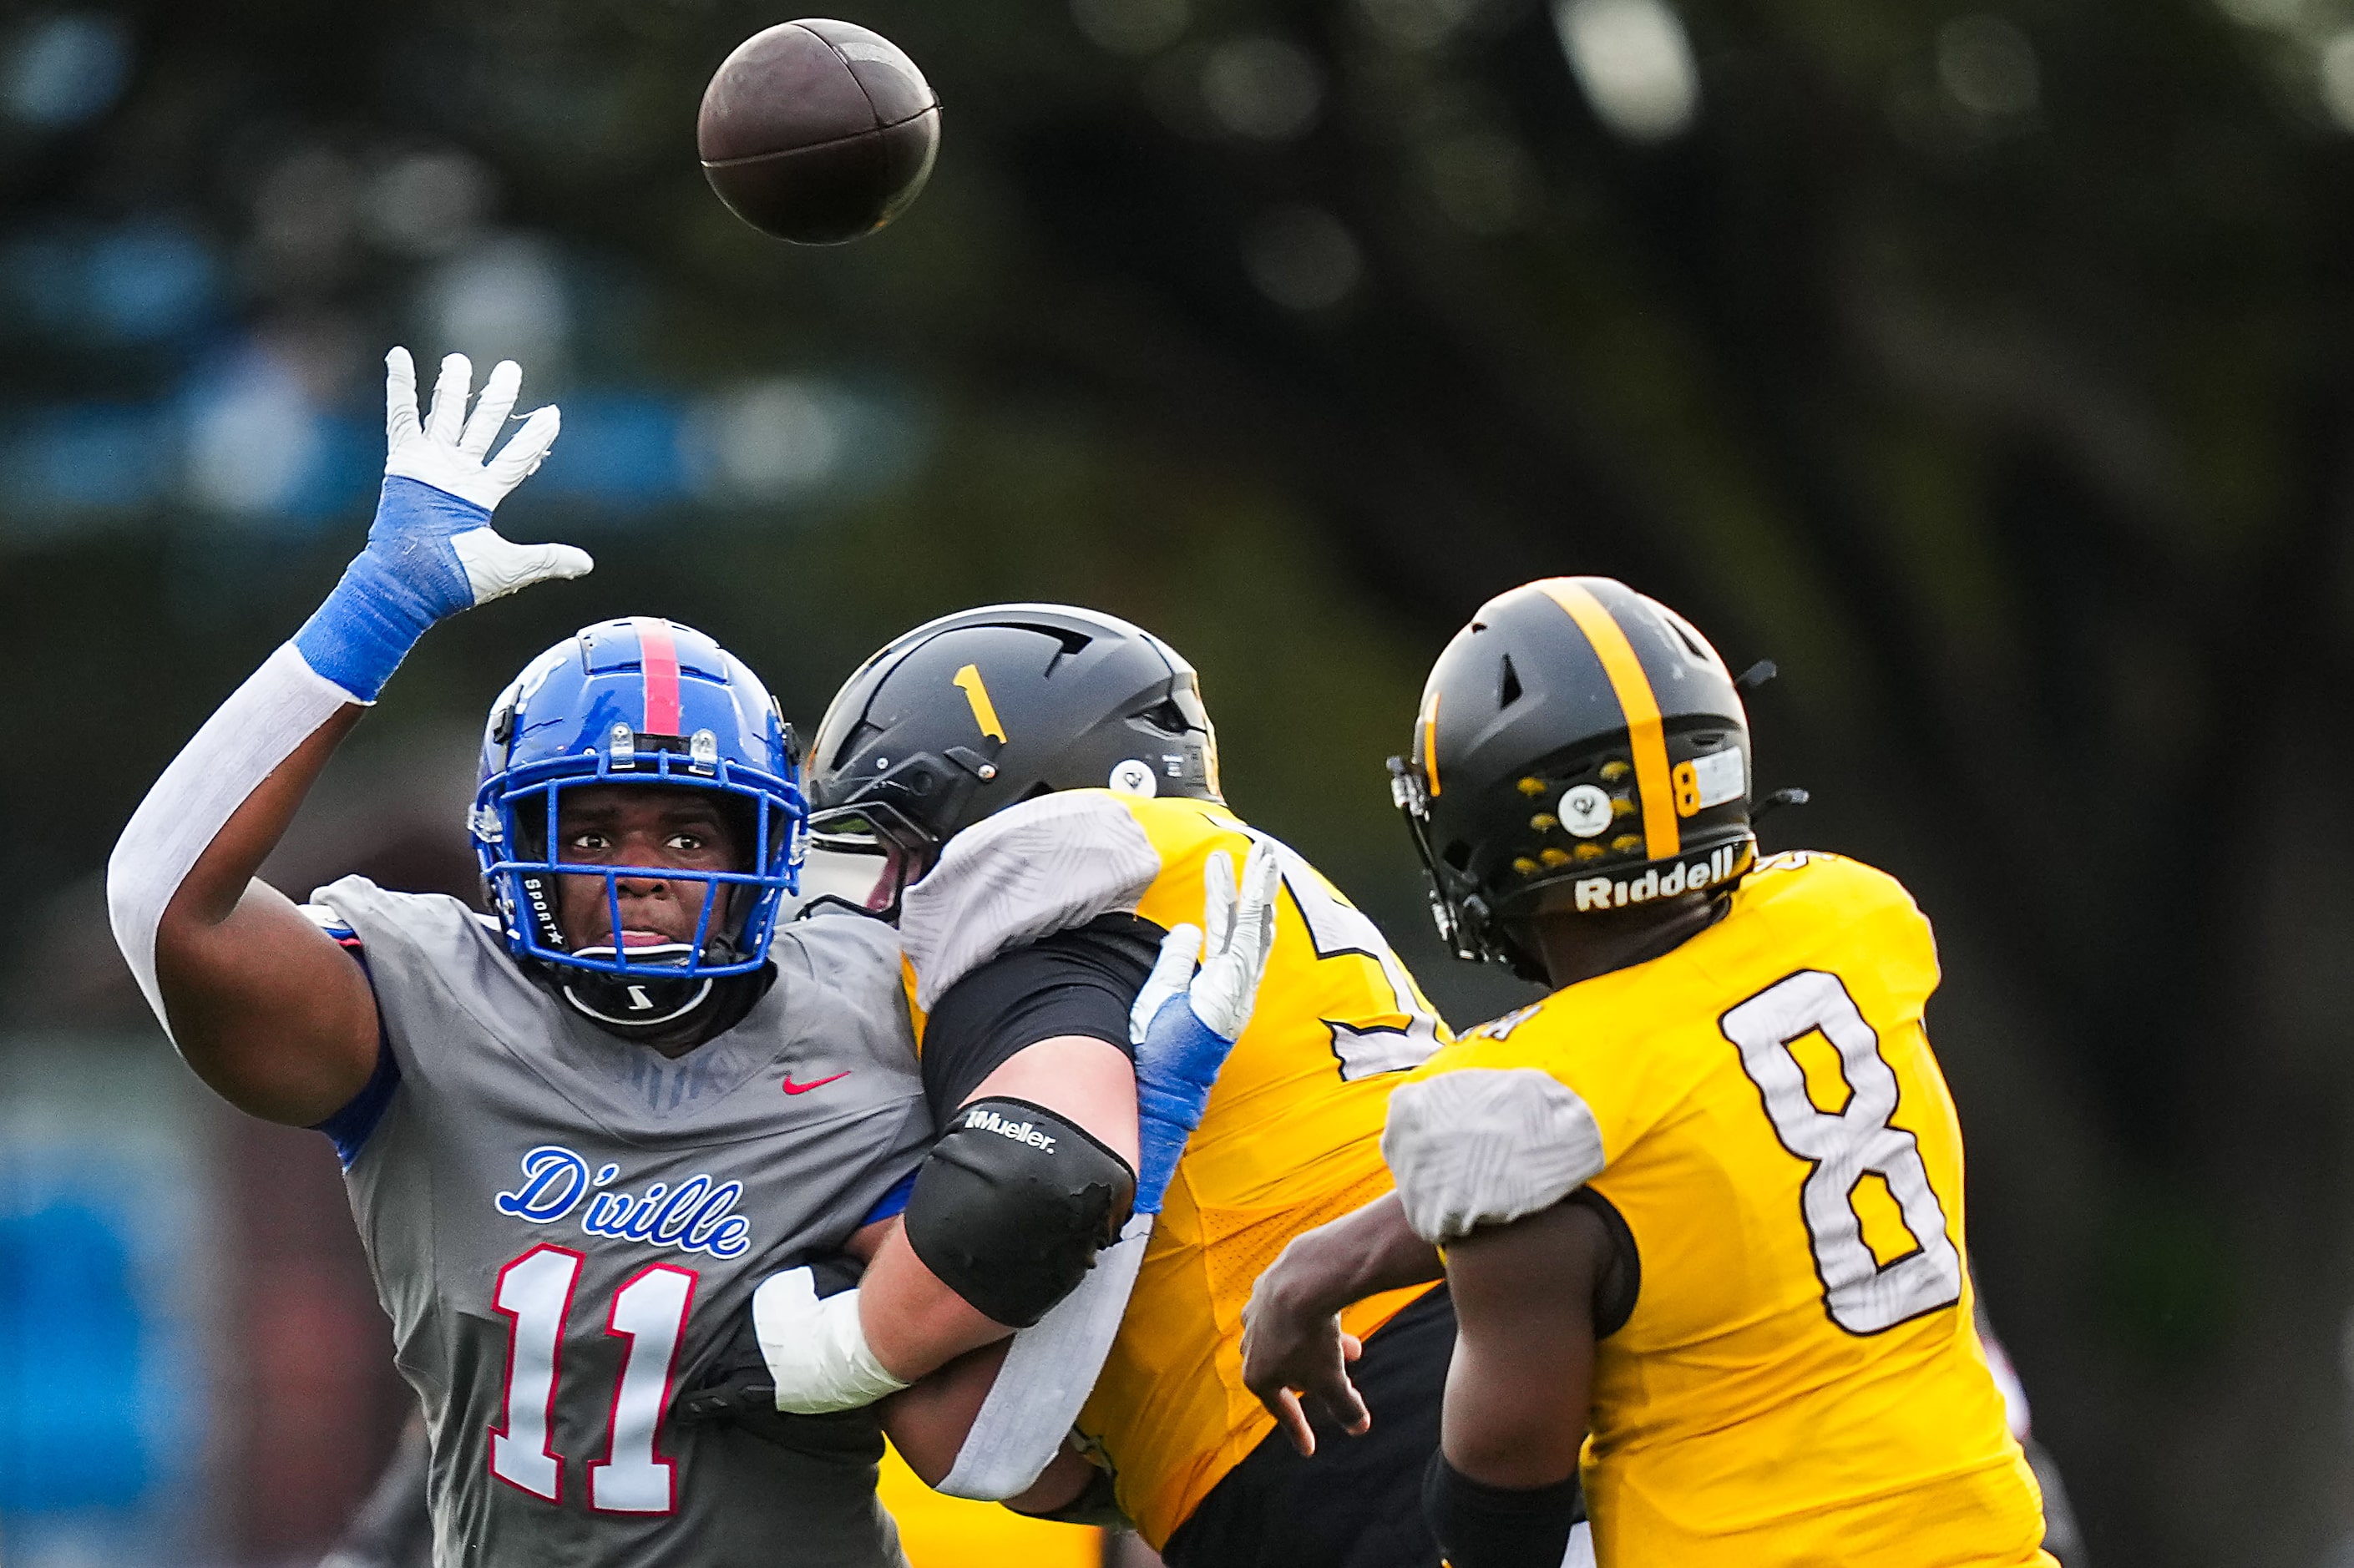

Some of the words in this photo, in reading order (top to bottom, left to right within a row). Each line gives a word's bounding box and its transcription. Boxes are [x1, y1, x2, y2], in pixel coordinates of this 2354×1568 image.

[1672, 760, 1702, 819] 8
[524, 878, 558, 931] SPORT
[1574, 844, 1734, 913] Riddell
[1718, 968, 1962, 1337] 8
[494, 1145, 751, 1260] D'ville
[488, 1242, 700, 1516] 11
